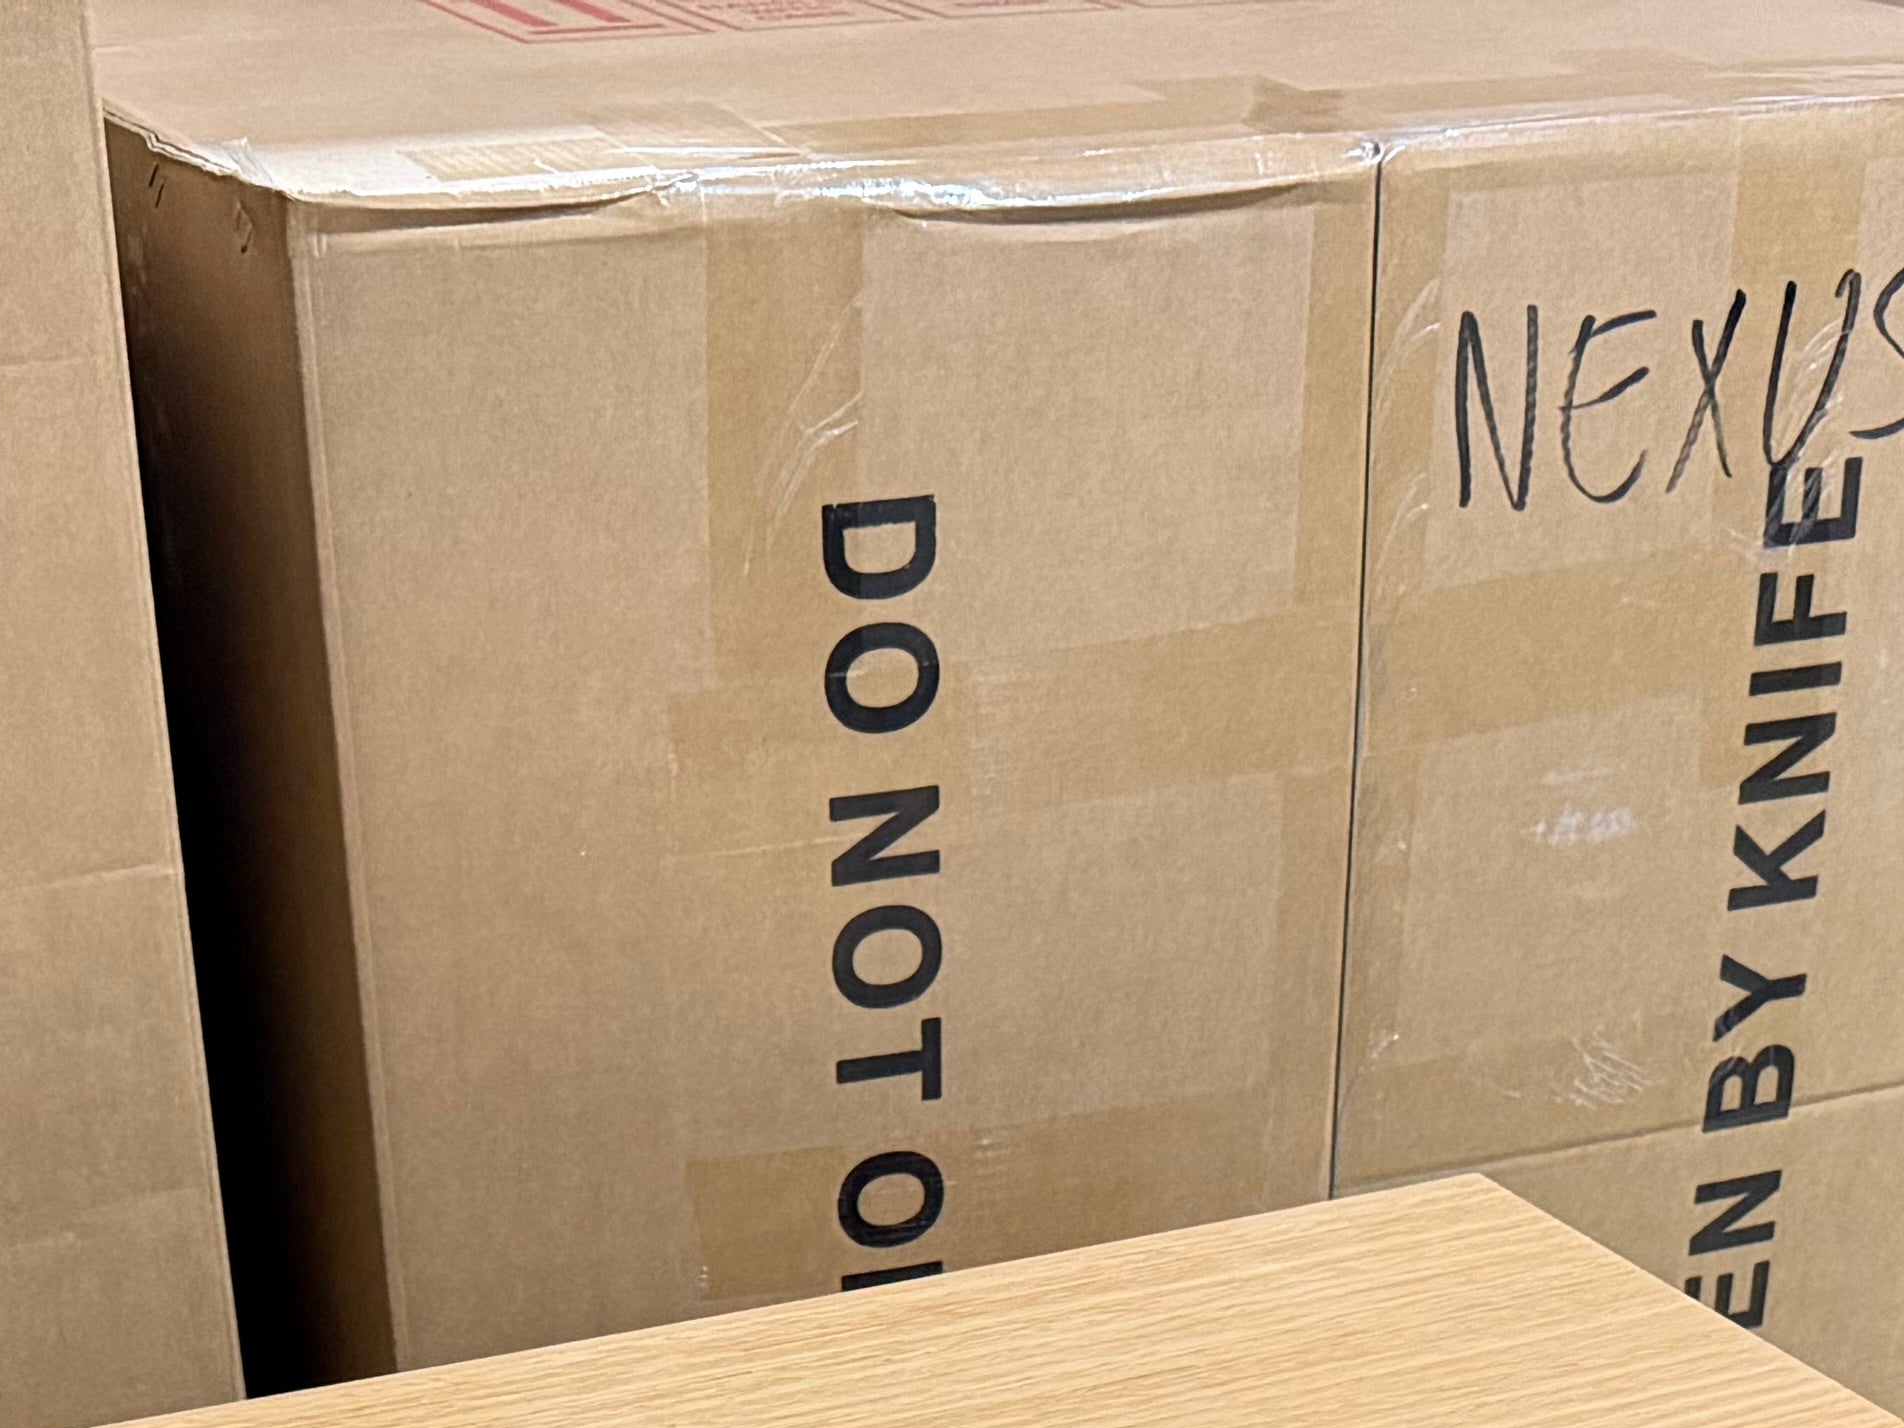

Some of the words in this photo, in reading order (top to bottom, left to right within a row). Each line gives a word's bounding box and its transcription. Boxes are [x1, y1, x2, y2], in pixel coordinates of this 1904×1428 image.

[822, 495, 940, 734] DO
[1728, 456, 1863, 911] KNIFE
[829, 785, 943, 1101] NOT
[1703, 955, 1807, 1133] BY
[837, 1150, 945, 1292] O
